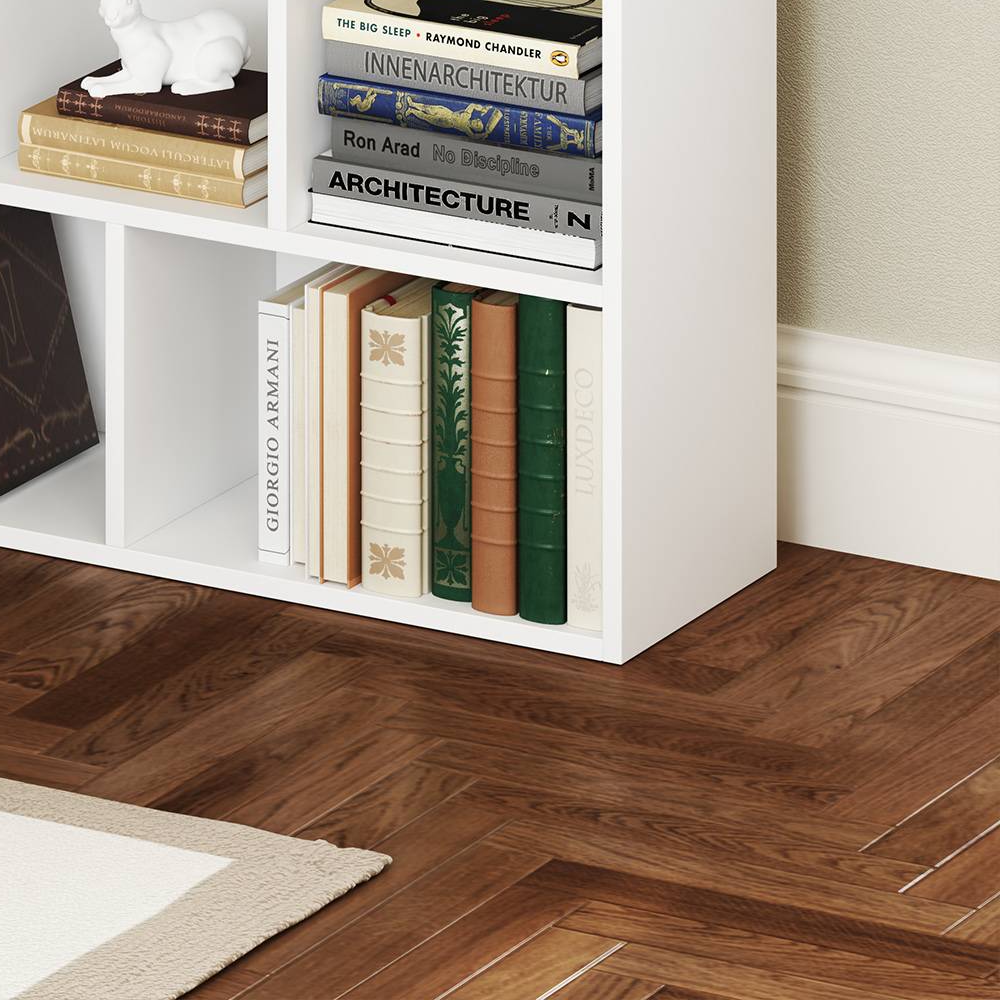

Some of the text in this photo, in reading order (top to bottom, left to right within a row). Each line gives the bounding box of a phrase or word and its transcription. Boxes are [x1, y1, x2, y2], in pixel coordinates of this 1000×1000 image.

[336, 17, 542, 60] THE BIG SLEEP RAYMOND CHANDLER
[364, 51, 569, 104] INNENARCHITEKTUR
[32, 126, 231, 170] LATERCULI VOCUM LATINARUM
[343, 130, 540, 178] Ron Arad No Discipline
[329, 170, 530, 222] ARCHITECTURE
[266, 338, 280, 533] GIORGIO ARMANI
[574, 366, 595, 497] LUXDECO
